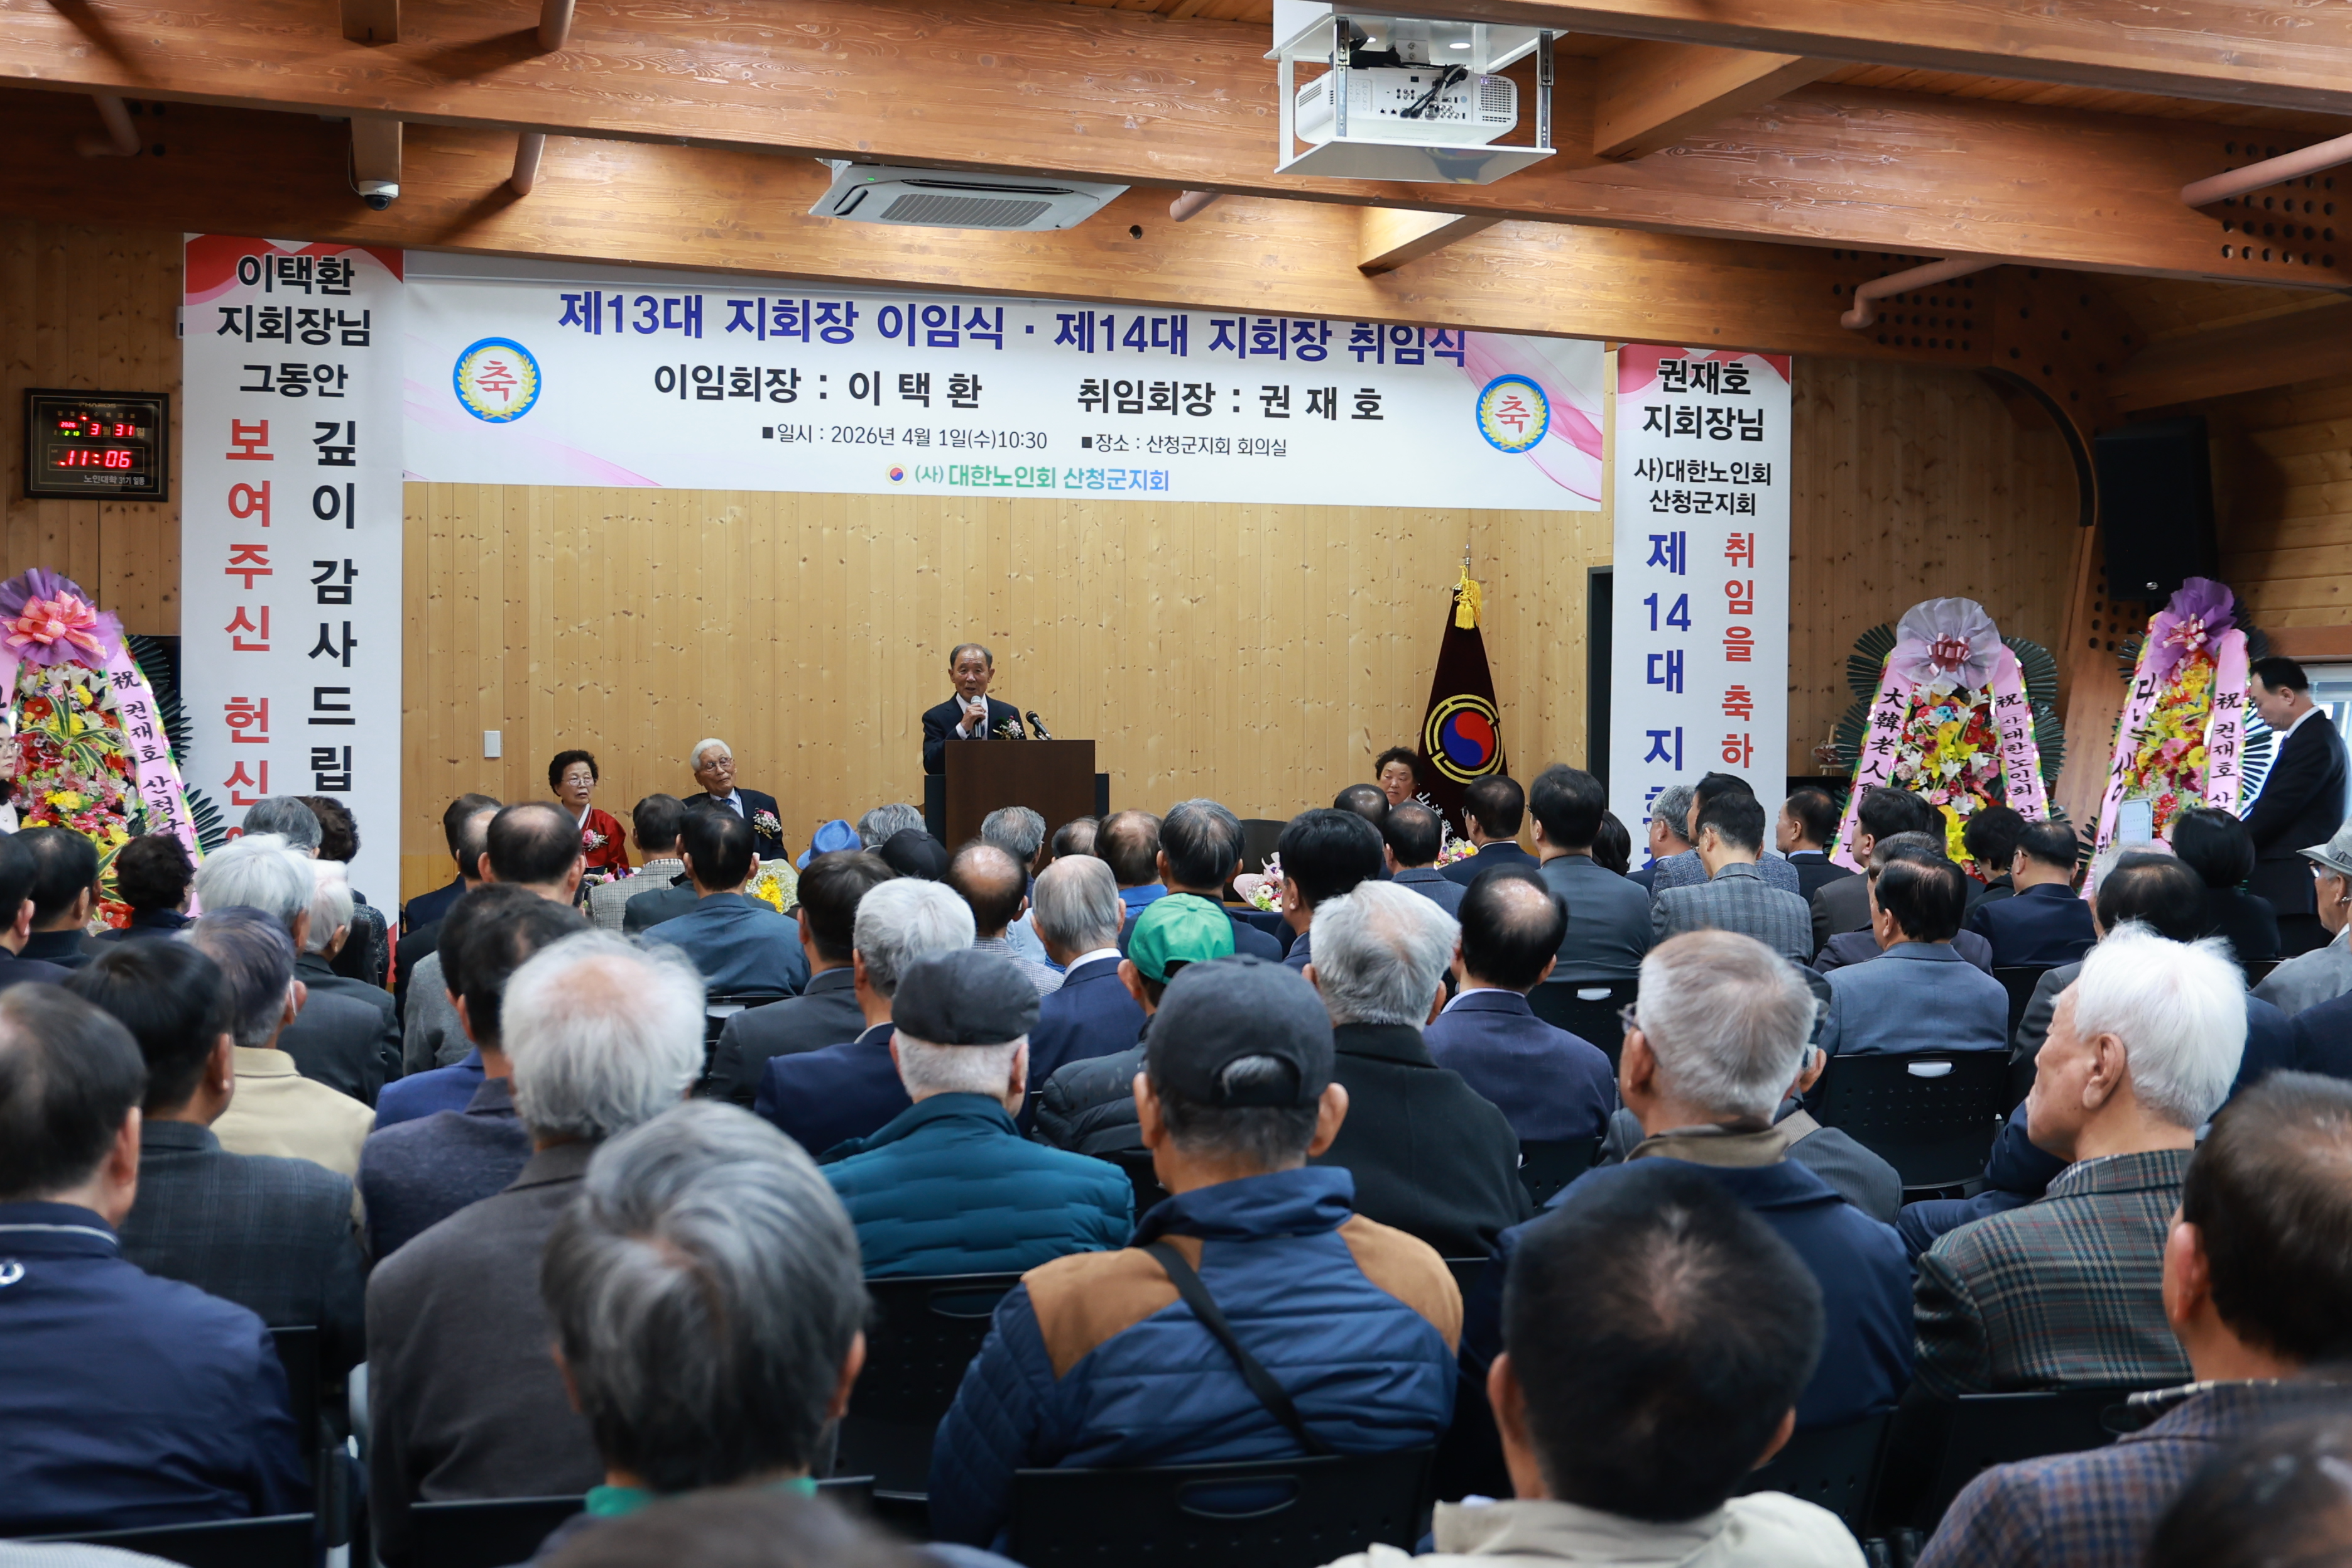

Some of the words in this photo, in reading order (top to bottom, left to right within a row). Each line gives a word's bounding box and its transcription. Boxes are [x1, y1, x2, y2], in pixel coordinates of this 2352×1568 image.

[237, 254, 355, 295] 이택환
[217, 305, 370, 347] 지회장님
[558, 290, 703, 339] 제13대
[725, 298, 859, 344] 지회장
[878, 303, 1004, 350] 이임식
[1054, 311, 1188, 357] 제14대
[1208, 317, 1332, 362] 지회장
[1348, 322, 1464, 368] 취임식
[239, 362, 349, 398] 그동안
[475, 360, 518, 402] 축
[655, 364, 802, 403] 이임회장
[849, 371, 881, 406] 이
[899, 373, 930, 408] 택
[947, 373, 983, 408] 환
[1658, 359, 1751, 395] 권재호
[1078, 378, 1216, 416] 취임회장
[1260, 384, 1291, 419] 권
[1305, 386, 1337, 421] 재
[1351, 388, 1384, 421] 호
[1495, 395, 1531, 433] 축
[90, 423, 102, 436] 3
[114, 423, 134, 437] 31
[777, 423, 813, 444] 일시
[831, 425, 895, 446] 2026년
[903, 428, 931, 447] 4월
[938, 428, 1048, 451] 1일(수)10:30
[1643, 404, 1763, 442] 지회장님
[67, 450, 132, 469] 11:06
[1095, 433, 1130, 452] 장소
[1146, 435, 1231, 455] 산청군지회
[1238, 437, 1287, 457] 회의실
[84, 475, 117, 484] 노인대학
[133, 476, 145, 485] 일동
[312, 421, 356, 529] 깊이
[915, 465, 944, 484] (사)
[949, 464, 1057, 489] 대한노인회
[1064, 467, 1170, 492] 산청군지회
[1634, 457, 1772, 486] 사)대한노인회
[1650, 489, 1756, 516] 산청군지회
[224, 419, 275, 651] 보여주신
[1643, 531, 1692, 694] 제14대
[1723, 532, 1755, 662] 취임을
[111, 670, 143, 689] 祝
[1996, 693, 2023, 708] 祝
[2215, 692, 2242, 710] 祝
[124, 700, 165, 764] 권재호
[2211, 721, 2237, 778] 권재호
